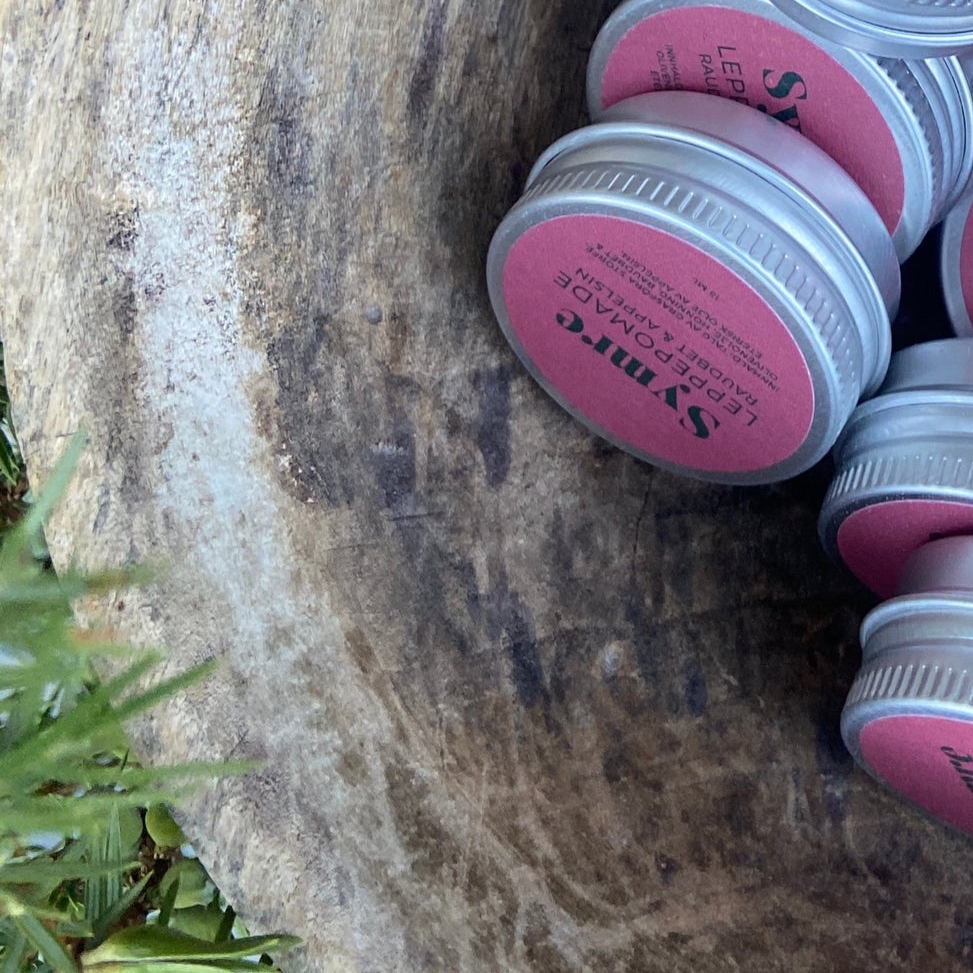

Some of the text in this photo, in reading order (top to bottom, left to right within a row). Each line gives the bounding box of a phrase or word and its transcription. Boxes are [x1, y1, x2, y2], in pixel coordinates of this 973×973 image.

[552, 270, 758, 427] LEPPEPOMADE
[555, 308, 721, 439] Symre
[575, 267, 759, 406] RAUDBET & APPELSIN
